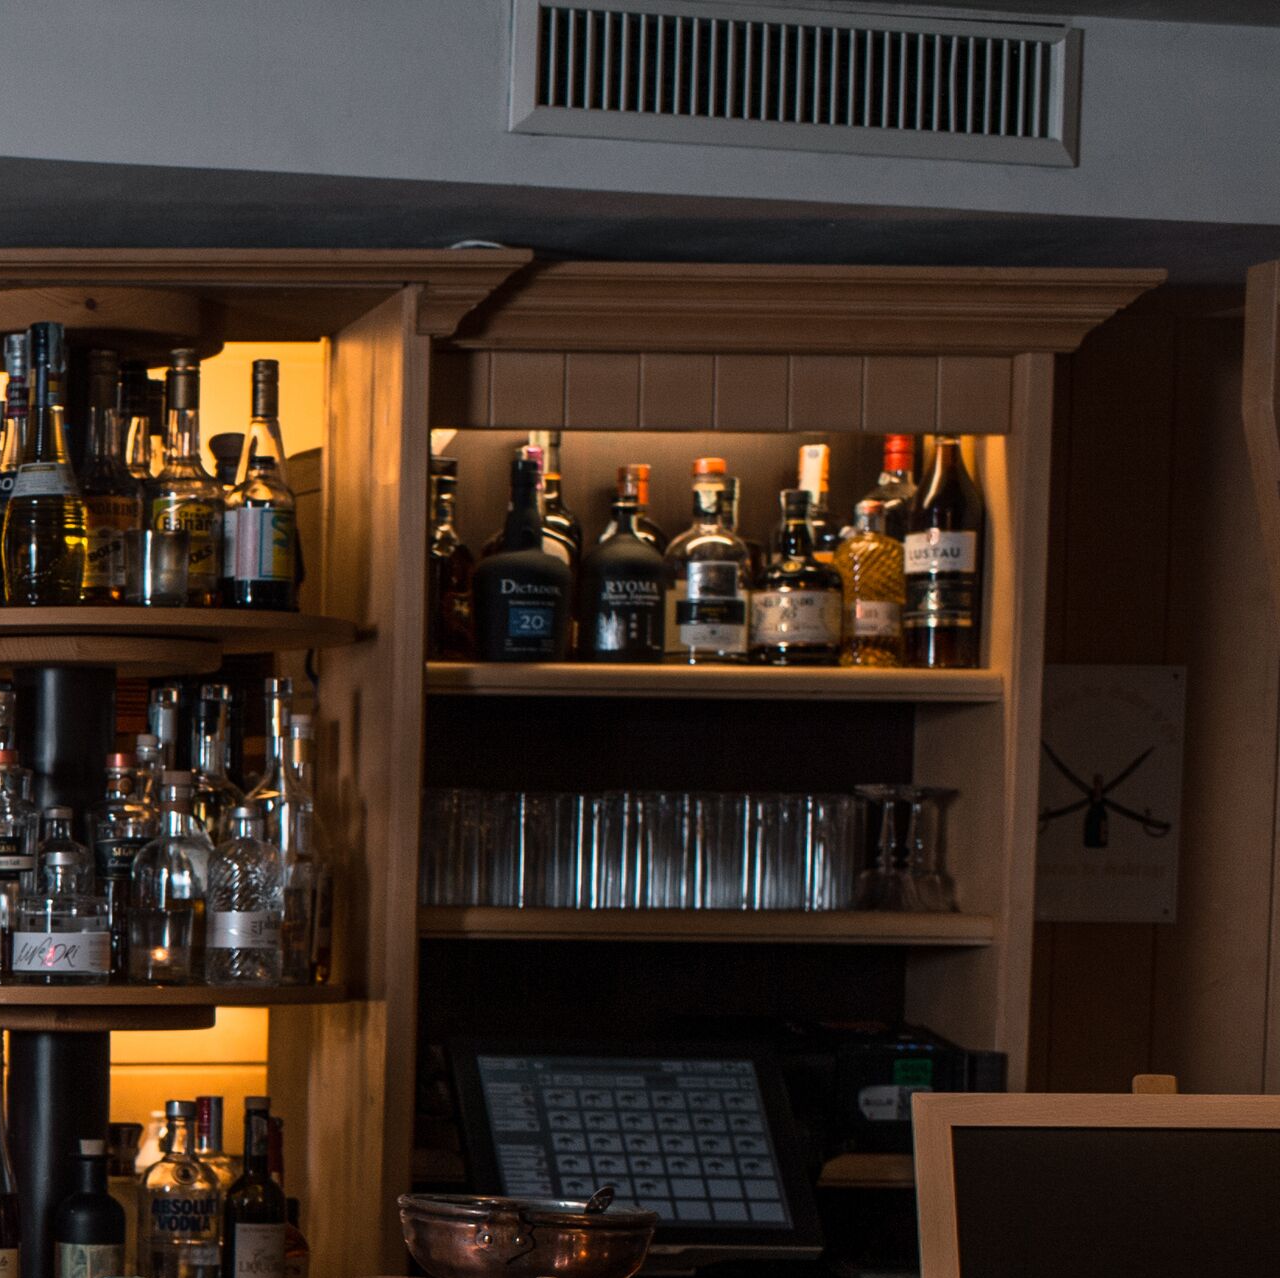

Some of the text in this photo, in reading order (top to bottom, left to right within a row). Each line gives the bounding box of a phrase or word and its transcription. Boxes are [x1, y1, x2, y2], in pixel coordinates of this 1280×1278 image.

[908, 547, 960, 559] LUSTAU
[604, 580, 658, 593] RYOMA
[520, 614, 545, 629] 20
[158, 1216, 211, 1232] VODKA
